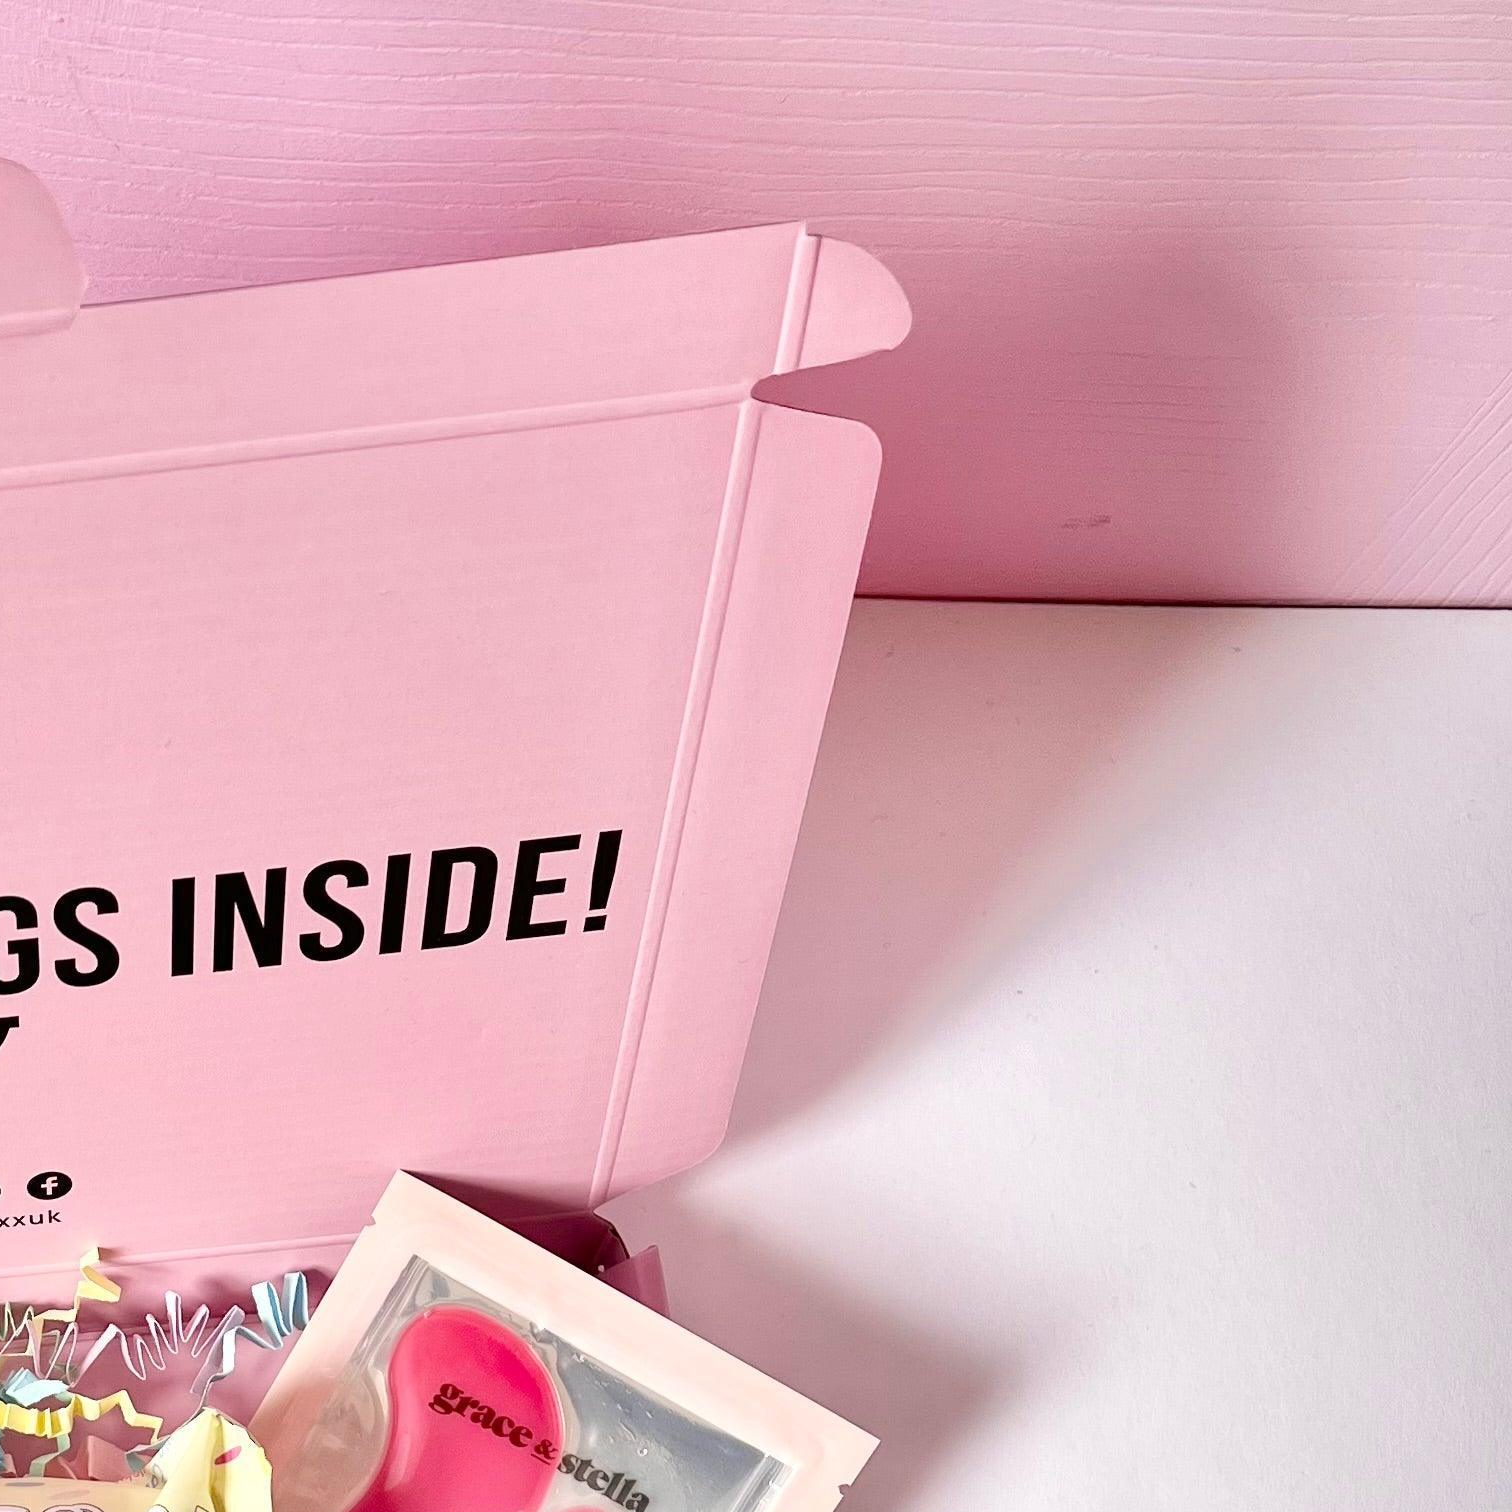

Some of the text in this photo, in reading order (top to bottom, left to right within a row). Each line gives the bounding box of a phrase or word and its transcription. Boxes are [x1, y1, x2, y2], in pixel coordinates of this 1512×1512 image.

[170, 829, 623, 978] INSIDE!
[427, 1381, 534, 1449] grace
[530, 1437, 559, 1466] &
